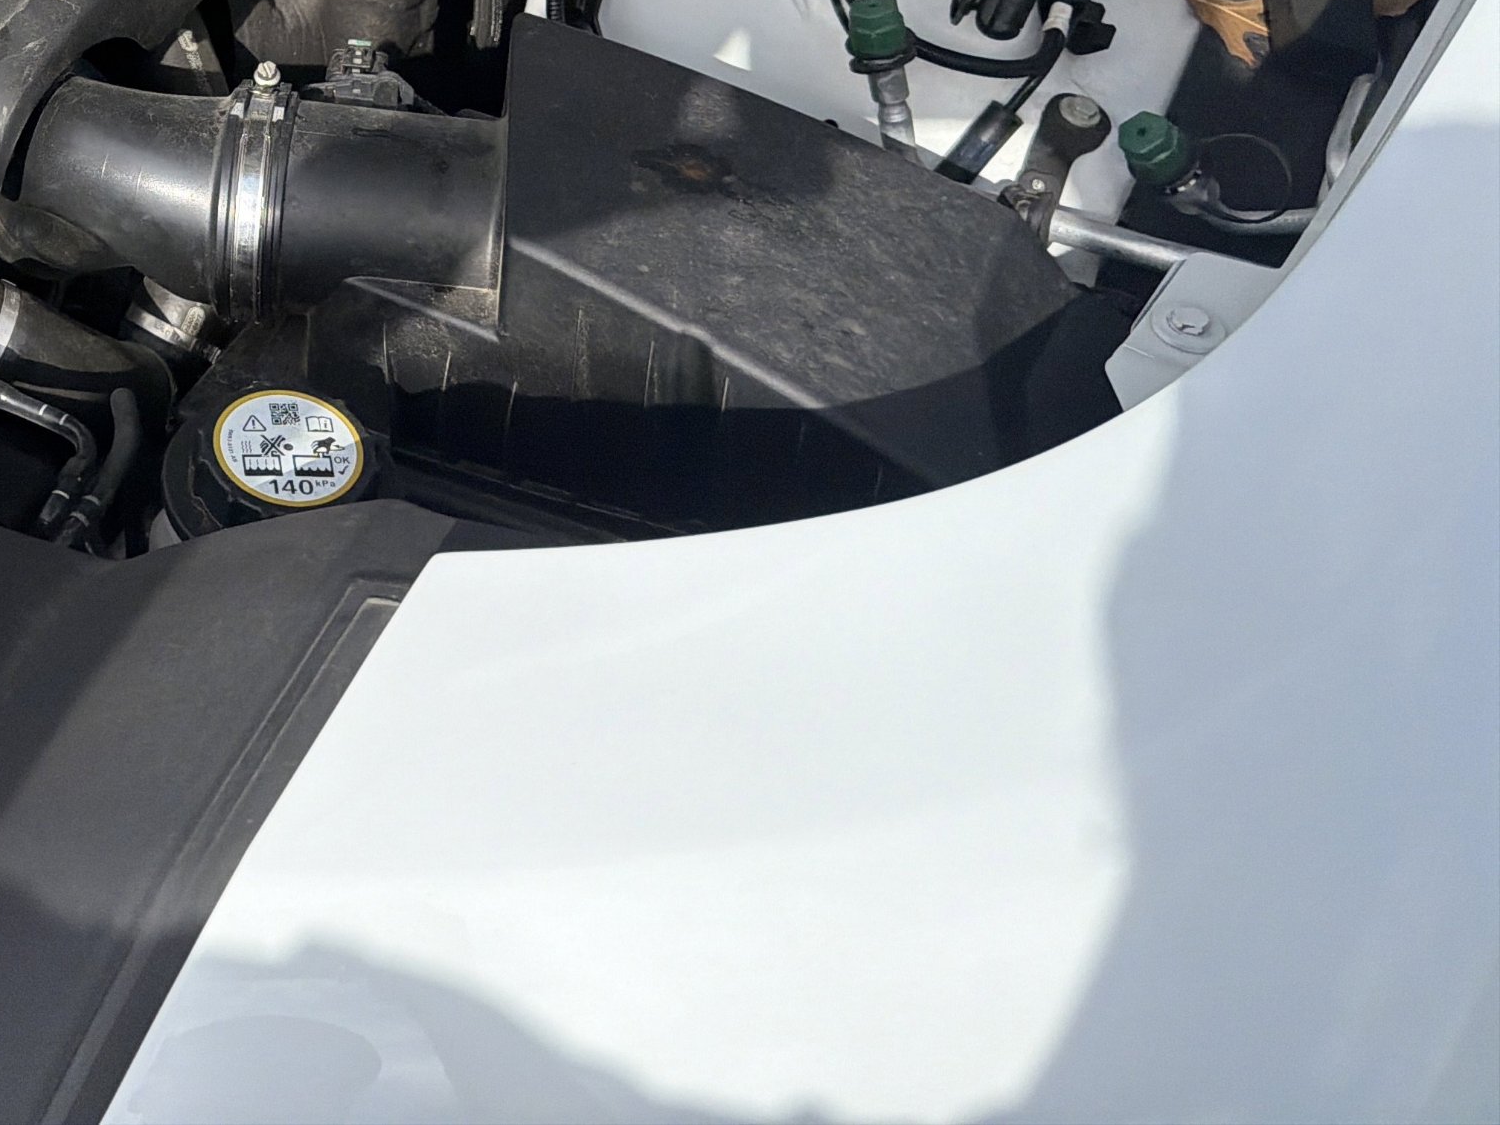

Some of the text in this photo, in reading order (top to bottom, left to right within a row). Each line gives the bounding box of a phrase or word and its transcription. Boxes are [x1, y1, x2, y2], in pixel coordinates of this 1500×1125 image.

[334, 455, 351, 465] OK
[269, 478, 336, 496] 140 kPa
